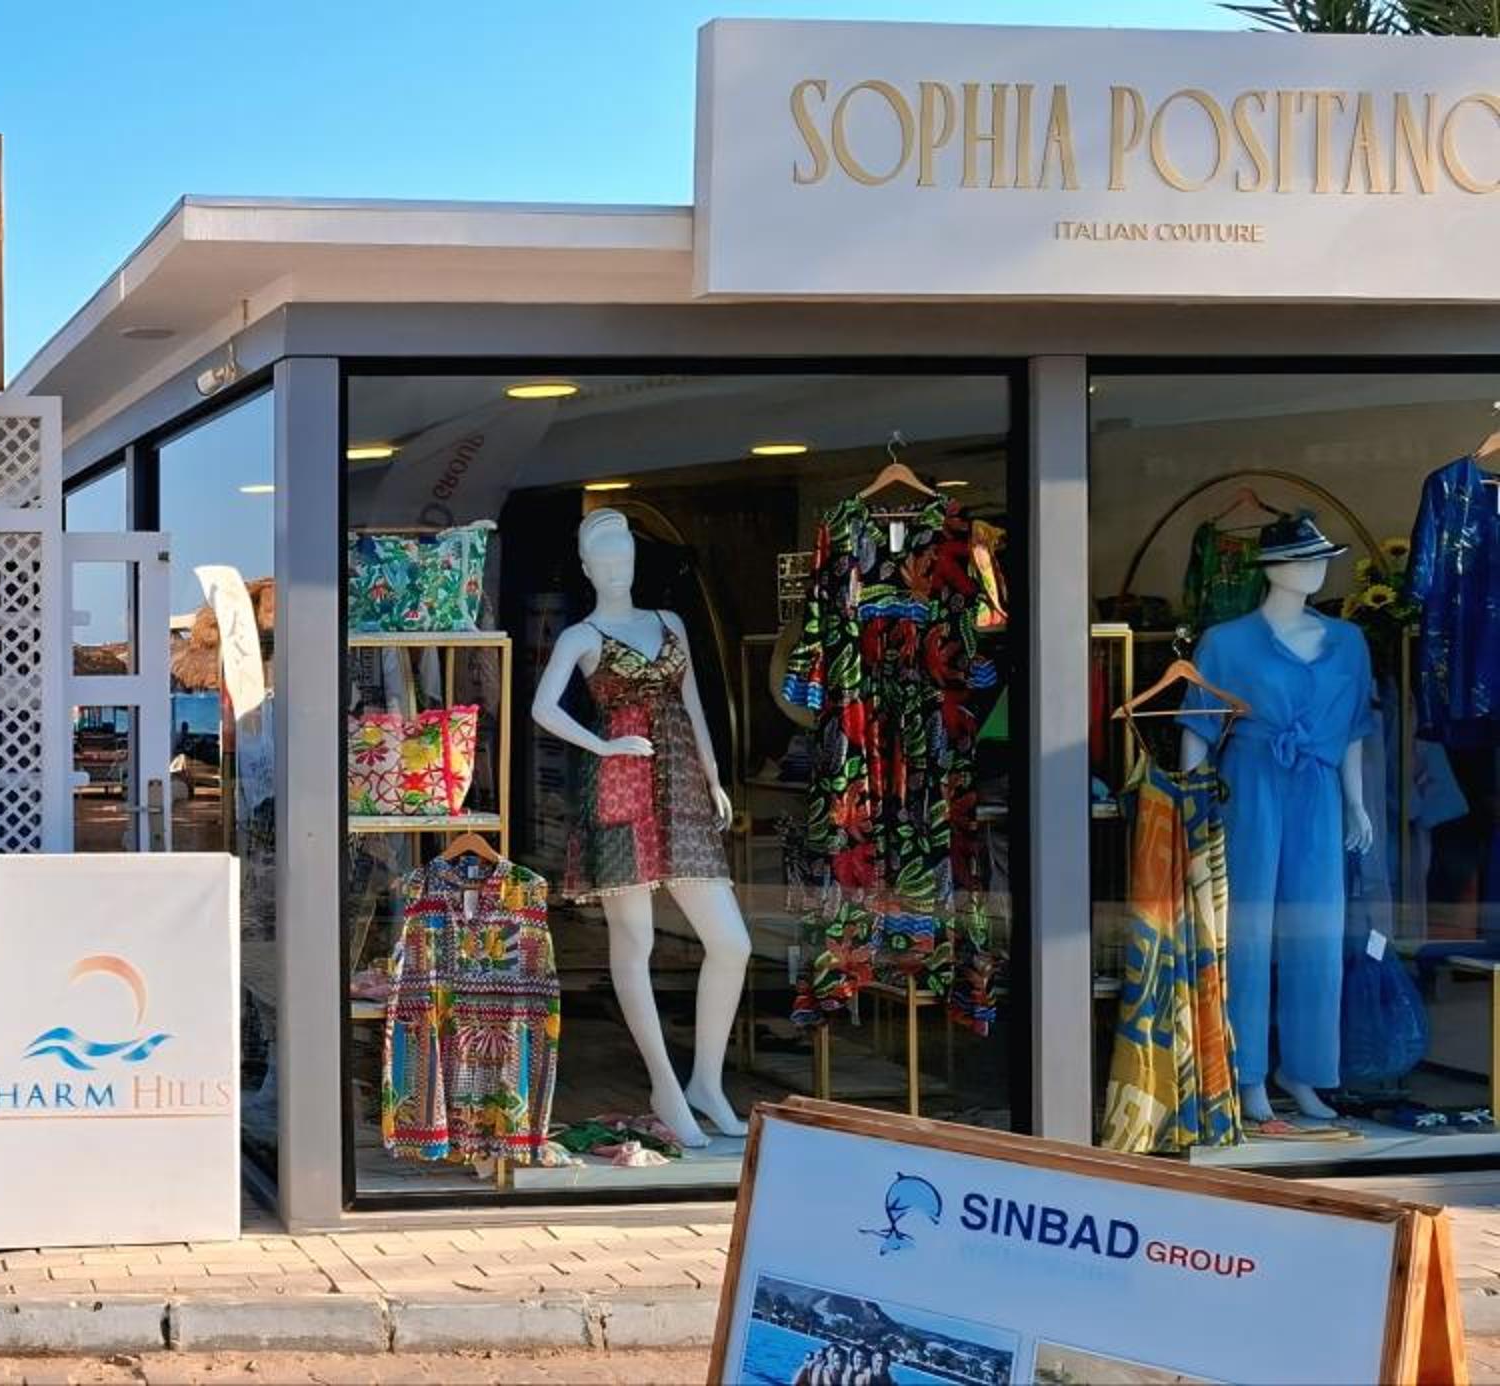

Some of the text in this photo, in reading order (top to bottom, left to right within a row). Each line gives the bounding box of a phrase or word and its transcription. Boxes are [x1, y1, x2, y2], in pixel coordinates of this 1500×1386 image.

[790, 80, 1500, 196] SOPHIA POSITANO
[1054, 221, 1266, 244] ITALIAN COUTURE
[132, 1075, 232, 1109] HILLS
[960, 1193, 1256, 1278] SINBAD GROUP
